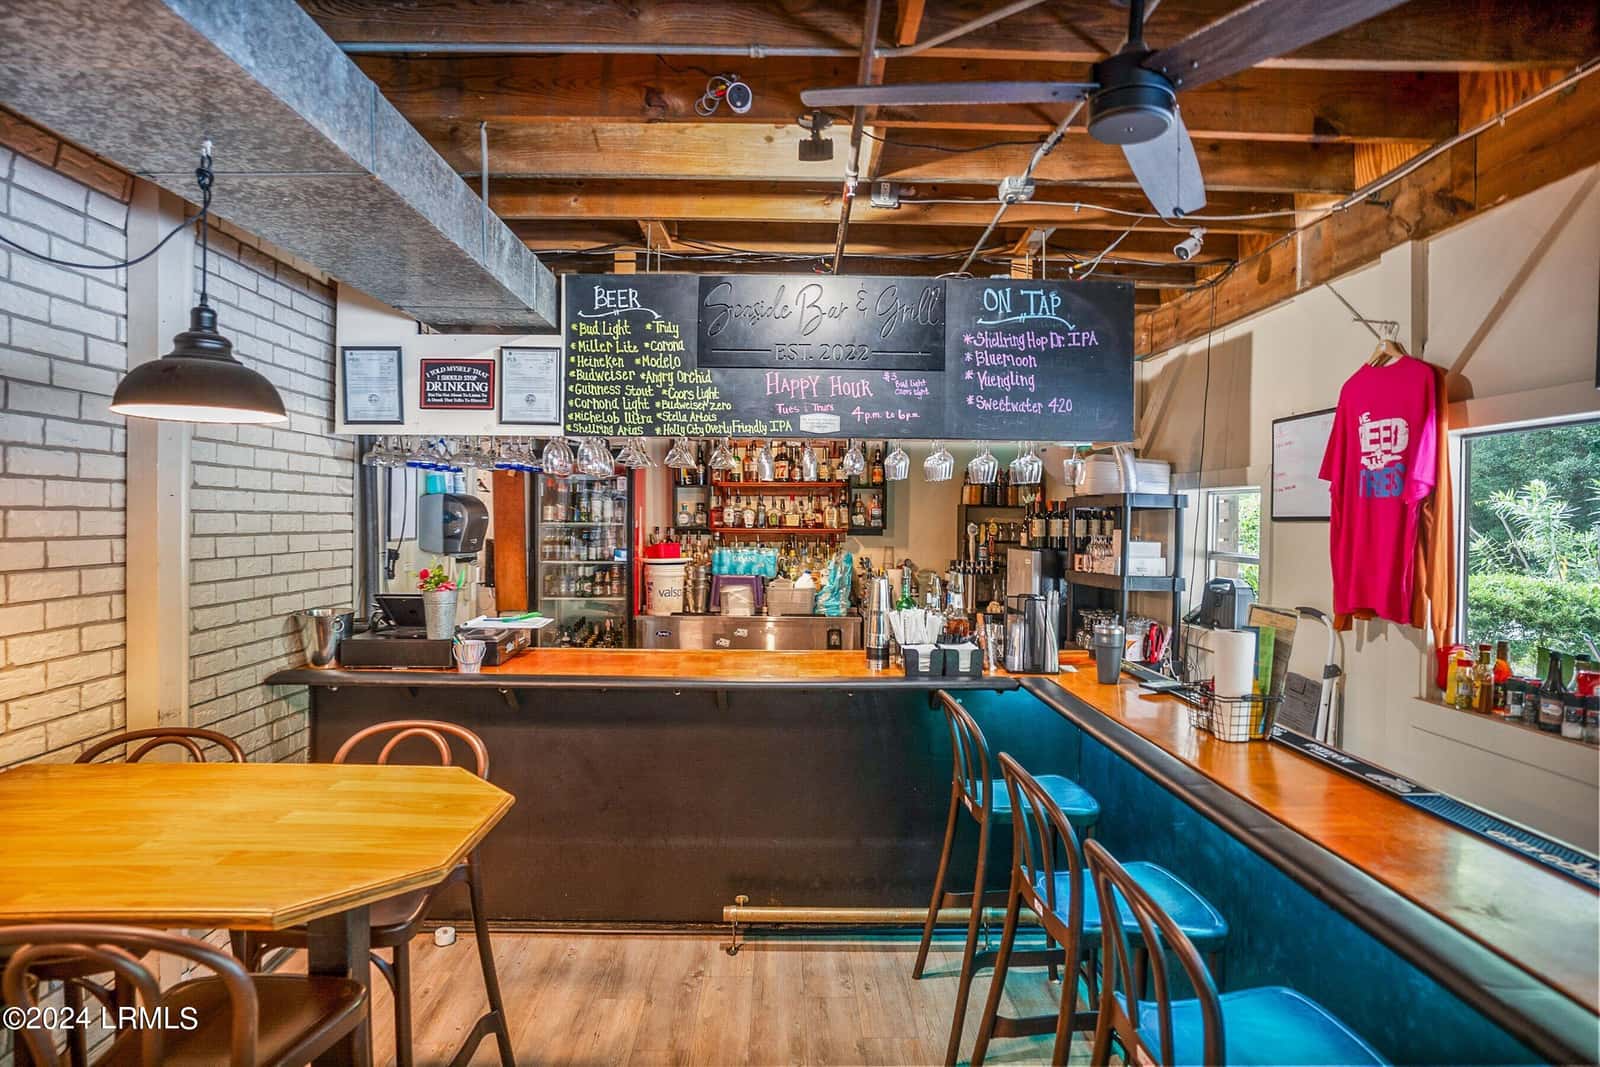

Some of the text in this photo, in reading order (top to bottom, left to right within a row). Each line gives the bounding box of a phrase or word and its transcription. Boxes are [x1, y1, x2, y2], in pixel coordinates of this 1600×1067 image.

[593, 285, 641, 310] BEER
[983, 287, 1061, 316] ON TAP
[703, 281, 792, 337] Seaside
[795, 283, 848, 337] Bar
[876, 284, 940, 339] Grill
[579, 320, 631, 340] Bud Light
[652, 320, 679, 338] Truly
[578, 339, 639, 353] Miller Lite
[650, 340, 685, 351] Corona
[1027, 331, 1048, 351] Hop
[1068, 331, 1099, 347] IPA
[775, 343, 870, 361] EST. 2022
[642, 353, 681, 369] Modelo
[576, 369, 636, 382] Budweiser
[645, 369, 713, 388] Angry Orchid
[426, 381, 488, 392] DRINKING
[574, 383, 654, 396] Guinness Stout
[668, 386, 719, 402] Coors Light
[623, 397, 650, 413] Light
[776, 403, 800, 415] Tues
[1048, 398, 1073, 413] 420
[769, 420, 793, 432] IPA
